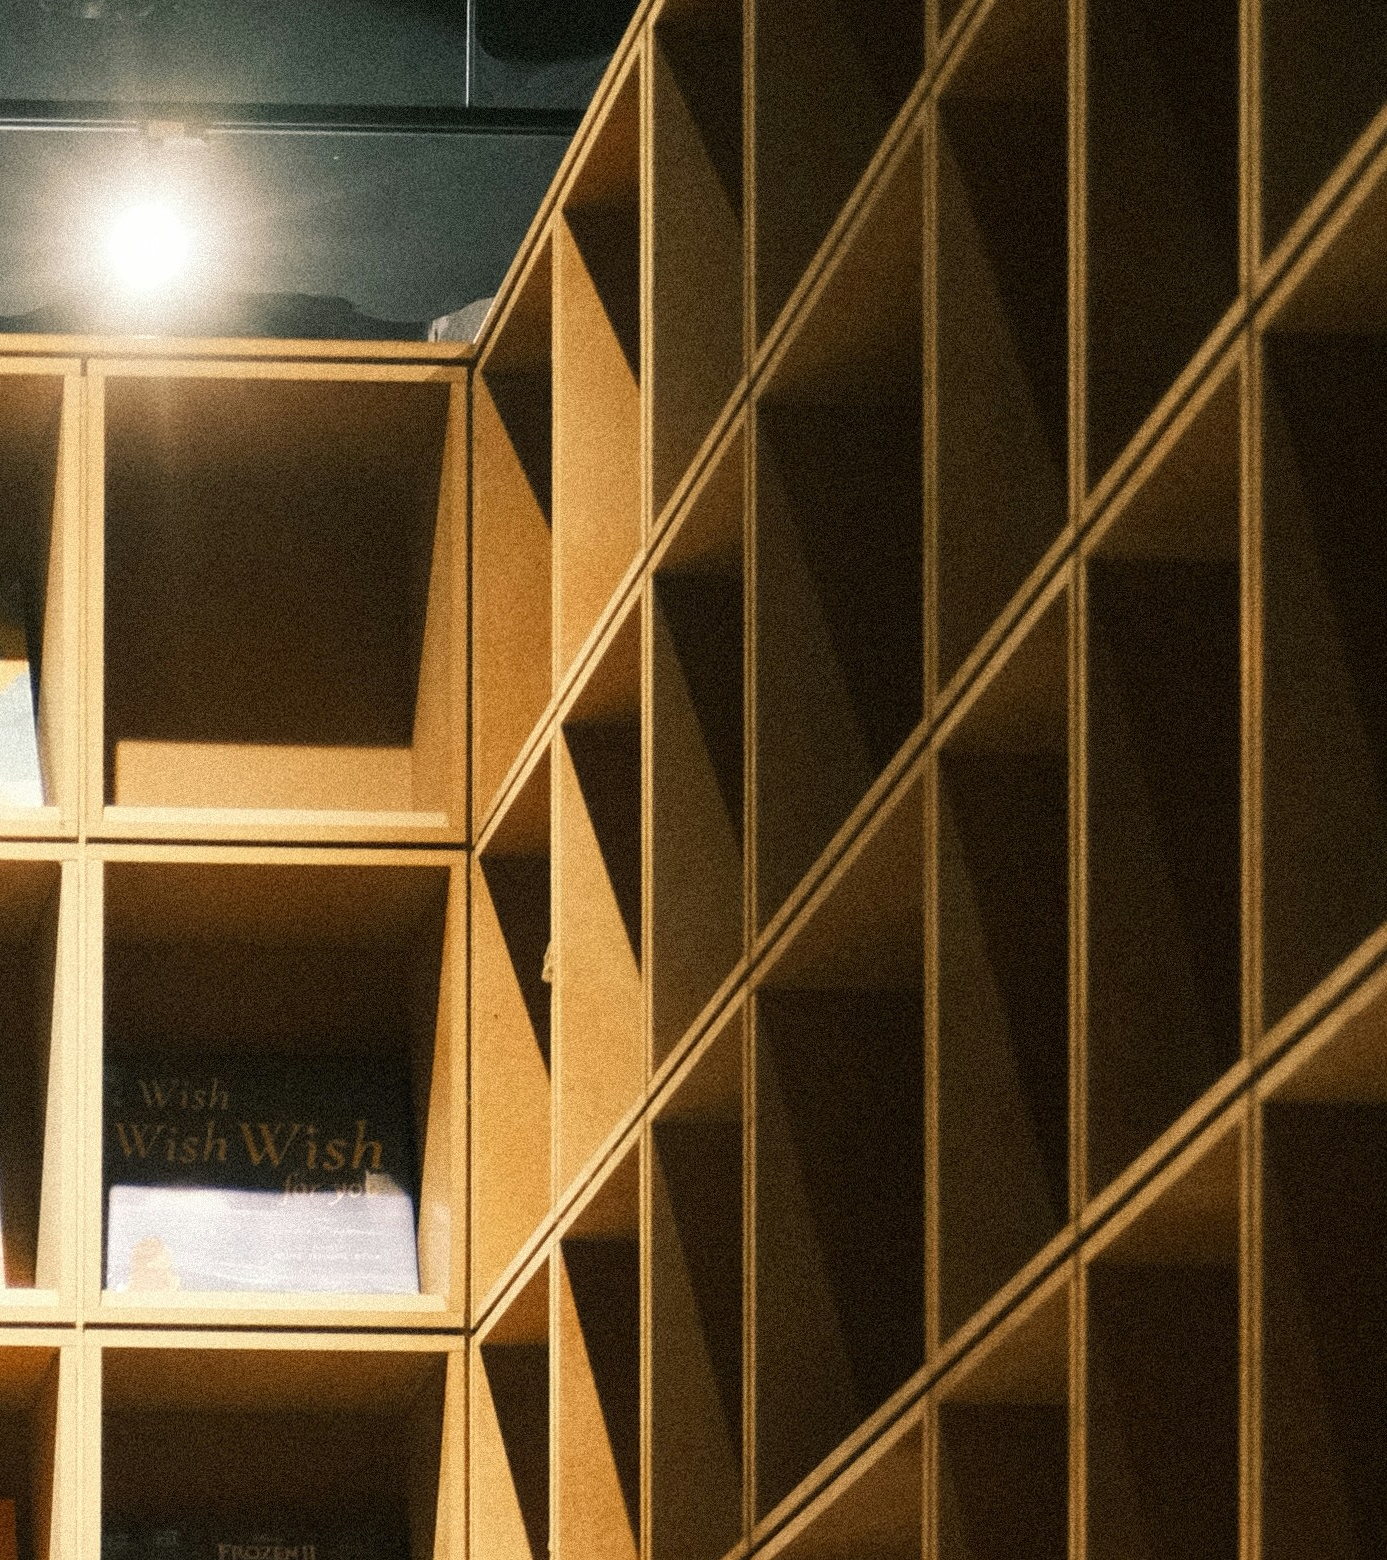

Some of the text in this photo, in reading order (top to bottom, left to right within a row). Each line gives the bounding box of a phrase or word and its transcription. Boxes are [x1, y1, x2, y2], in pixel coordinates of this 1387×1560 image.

[137, 1077, 230, 1111] Wish
[113, 1117, 384, 1172] Wish Wish
